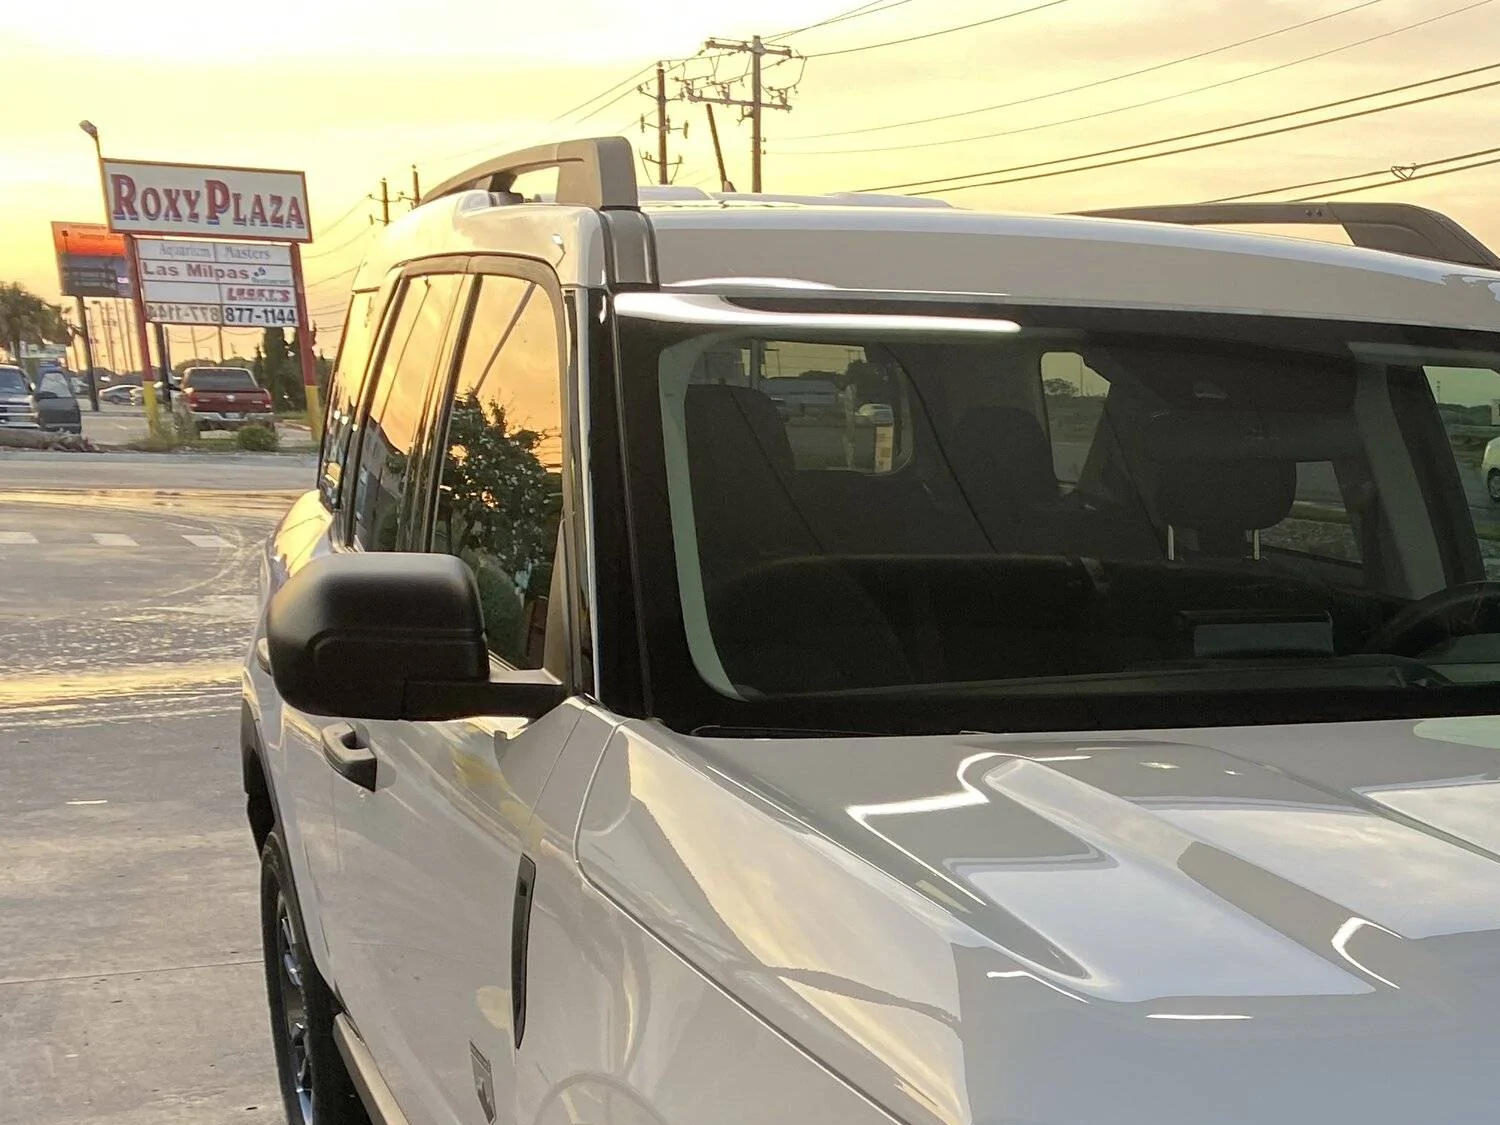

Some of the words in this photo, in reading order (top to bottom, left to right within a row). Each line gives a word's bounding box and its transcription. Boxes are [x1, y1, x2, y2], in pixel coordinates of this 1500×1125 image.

[143, 261, 179, 277] Las
[187, 263, 249, 281] Milpas
[224, 307, 296, 324] 877-1144
